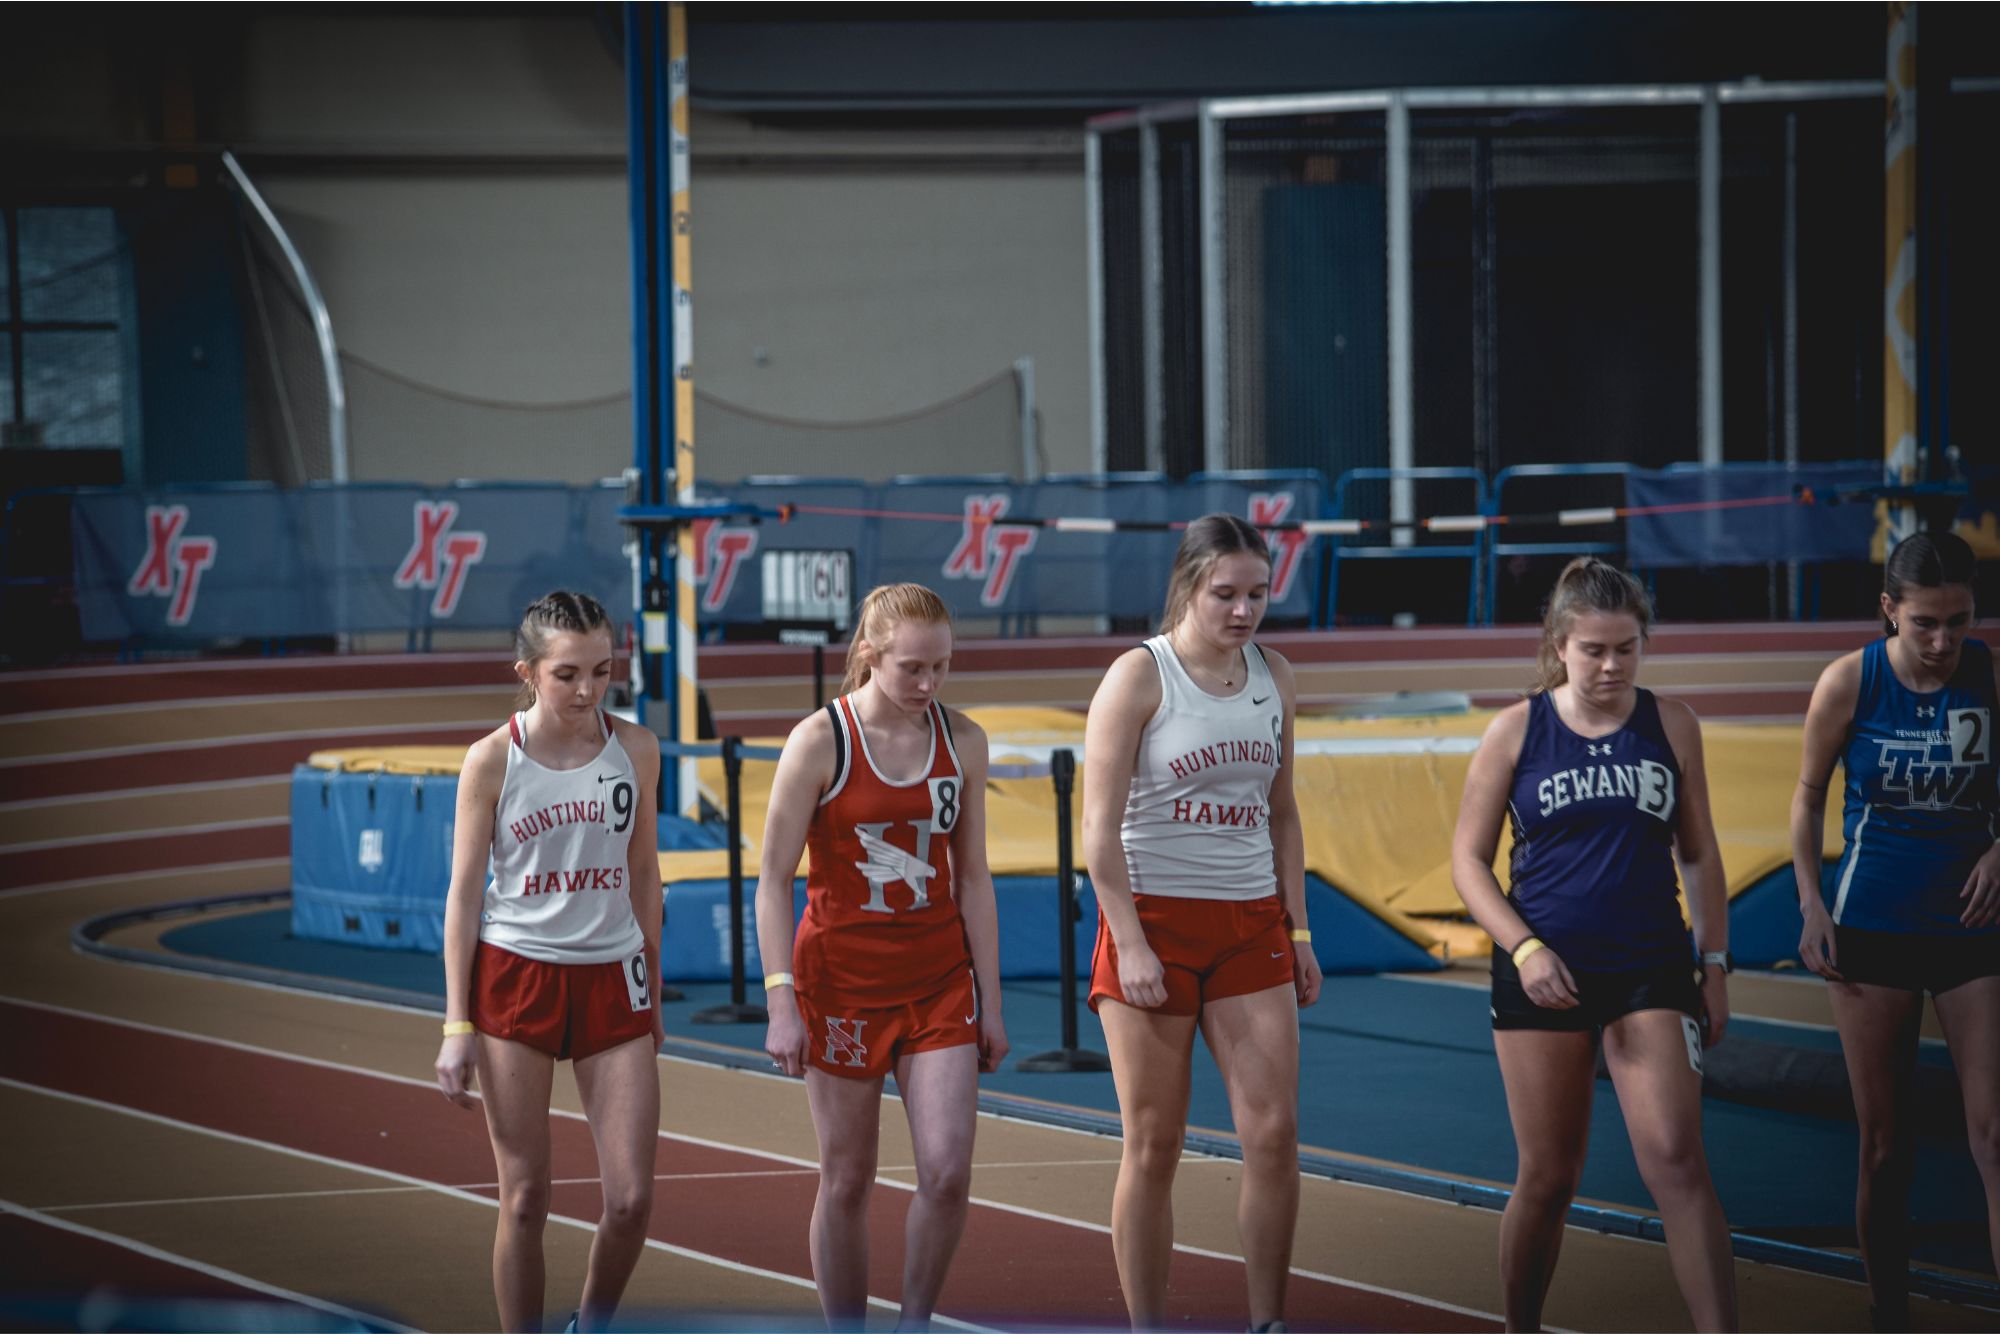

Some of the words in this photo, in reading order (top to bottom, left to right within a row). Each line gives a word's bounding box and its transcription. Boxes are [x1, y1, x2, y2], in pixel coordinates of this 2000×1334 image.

[127, 504, 218, 626] XT
[392, 500, 488, 618] XT
[941, 493, 1038, 607] XT
[1168, 740, 1275, 779] HUNTINGD
[1959, 712, 1985, 762] 2
[612, 781, 633, 833] 9
[937, 780, 955, 830] 8
[1538, 764, 1645, 818] SEWAN
[1647, 766, 1668, 813] 3
[523, 867, 623, 896] HAWKS
[631, 955, 649, 1006] 9
